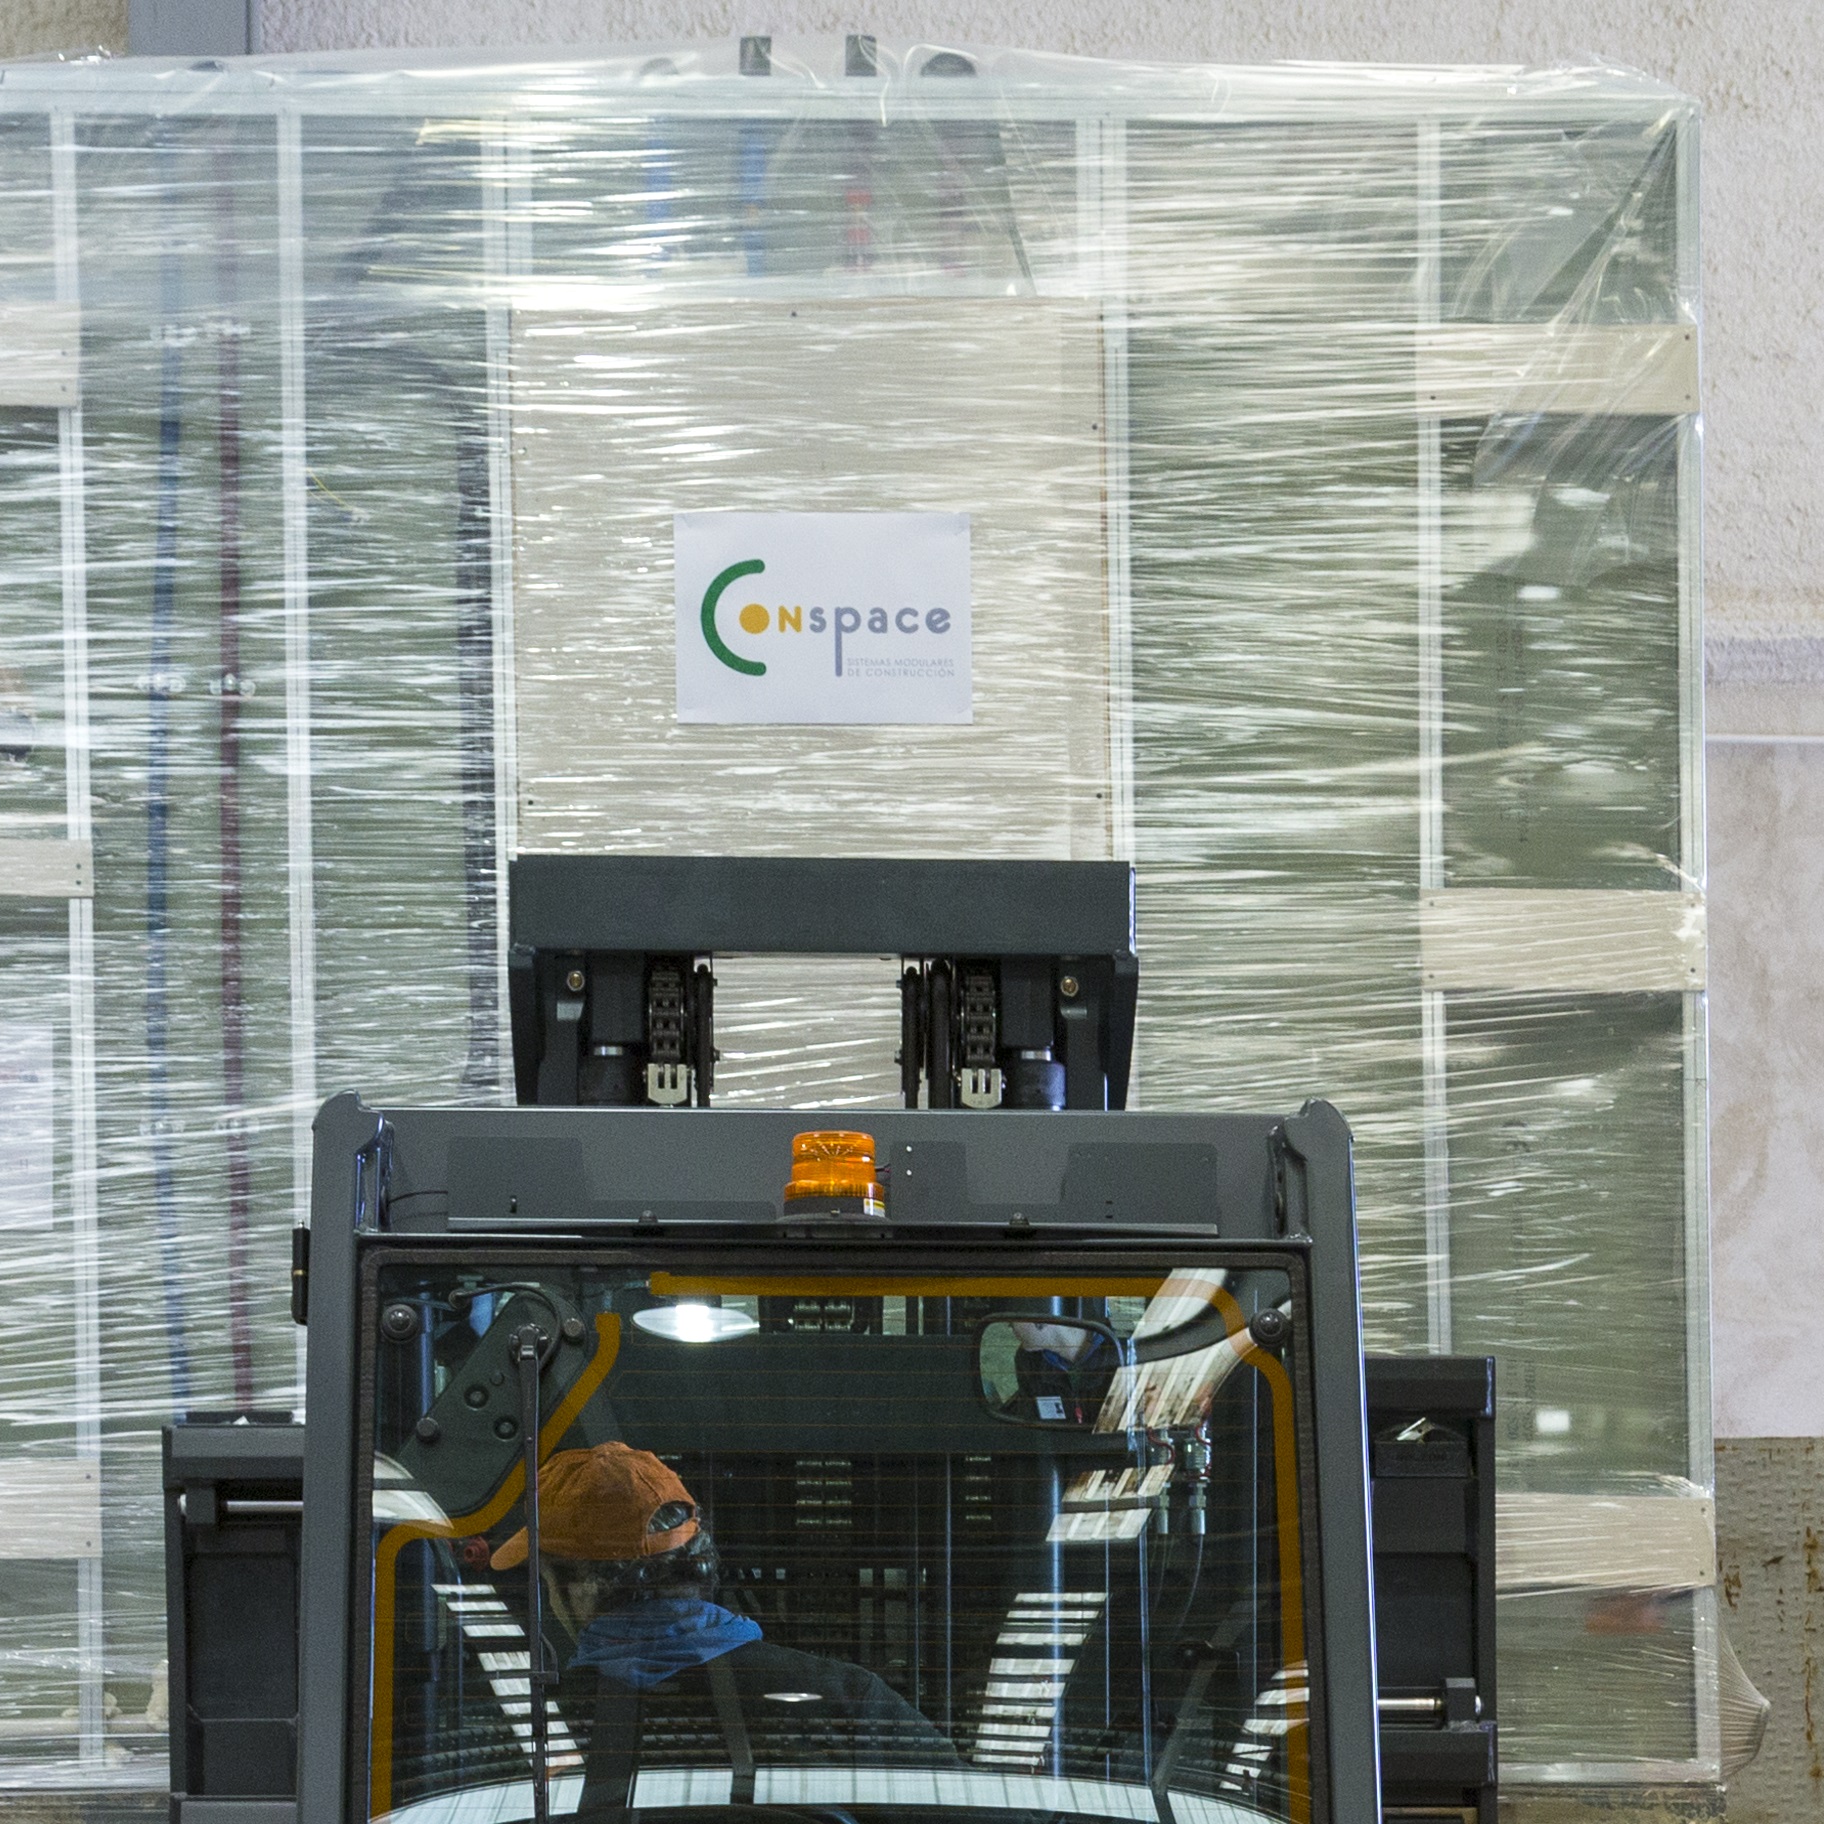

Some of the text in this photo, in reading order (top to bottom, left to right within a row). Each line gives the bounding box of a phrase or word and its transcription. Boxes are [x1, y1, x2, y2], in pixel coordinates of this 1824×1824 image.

[847, 658, 954, 668] SISTEMAS MODULARES
[847, 666, 955, 678] DE CONSTRUCCIÓN
